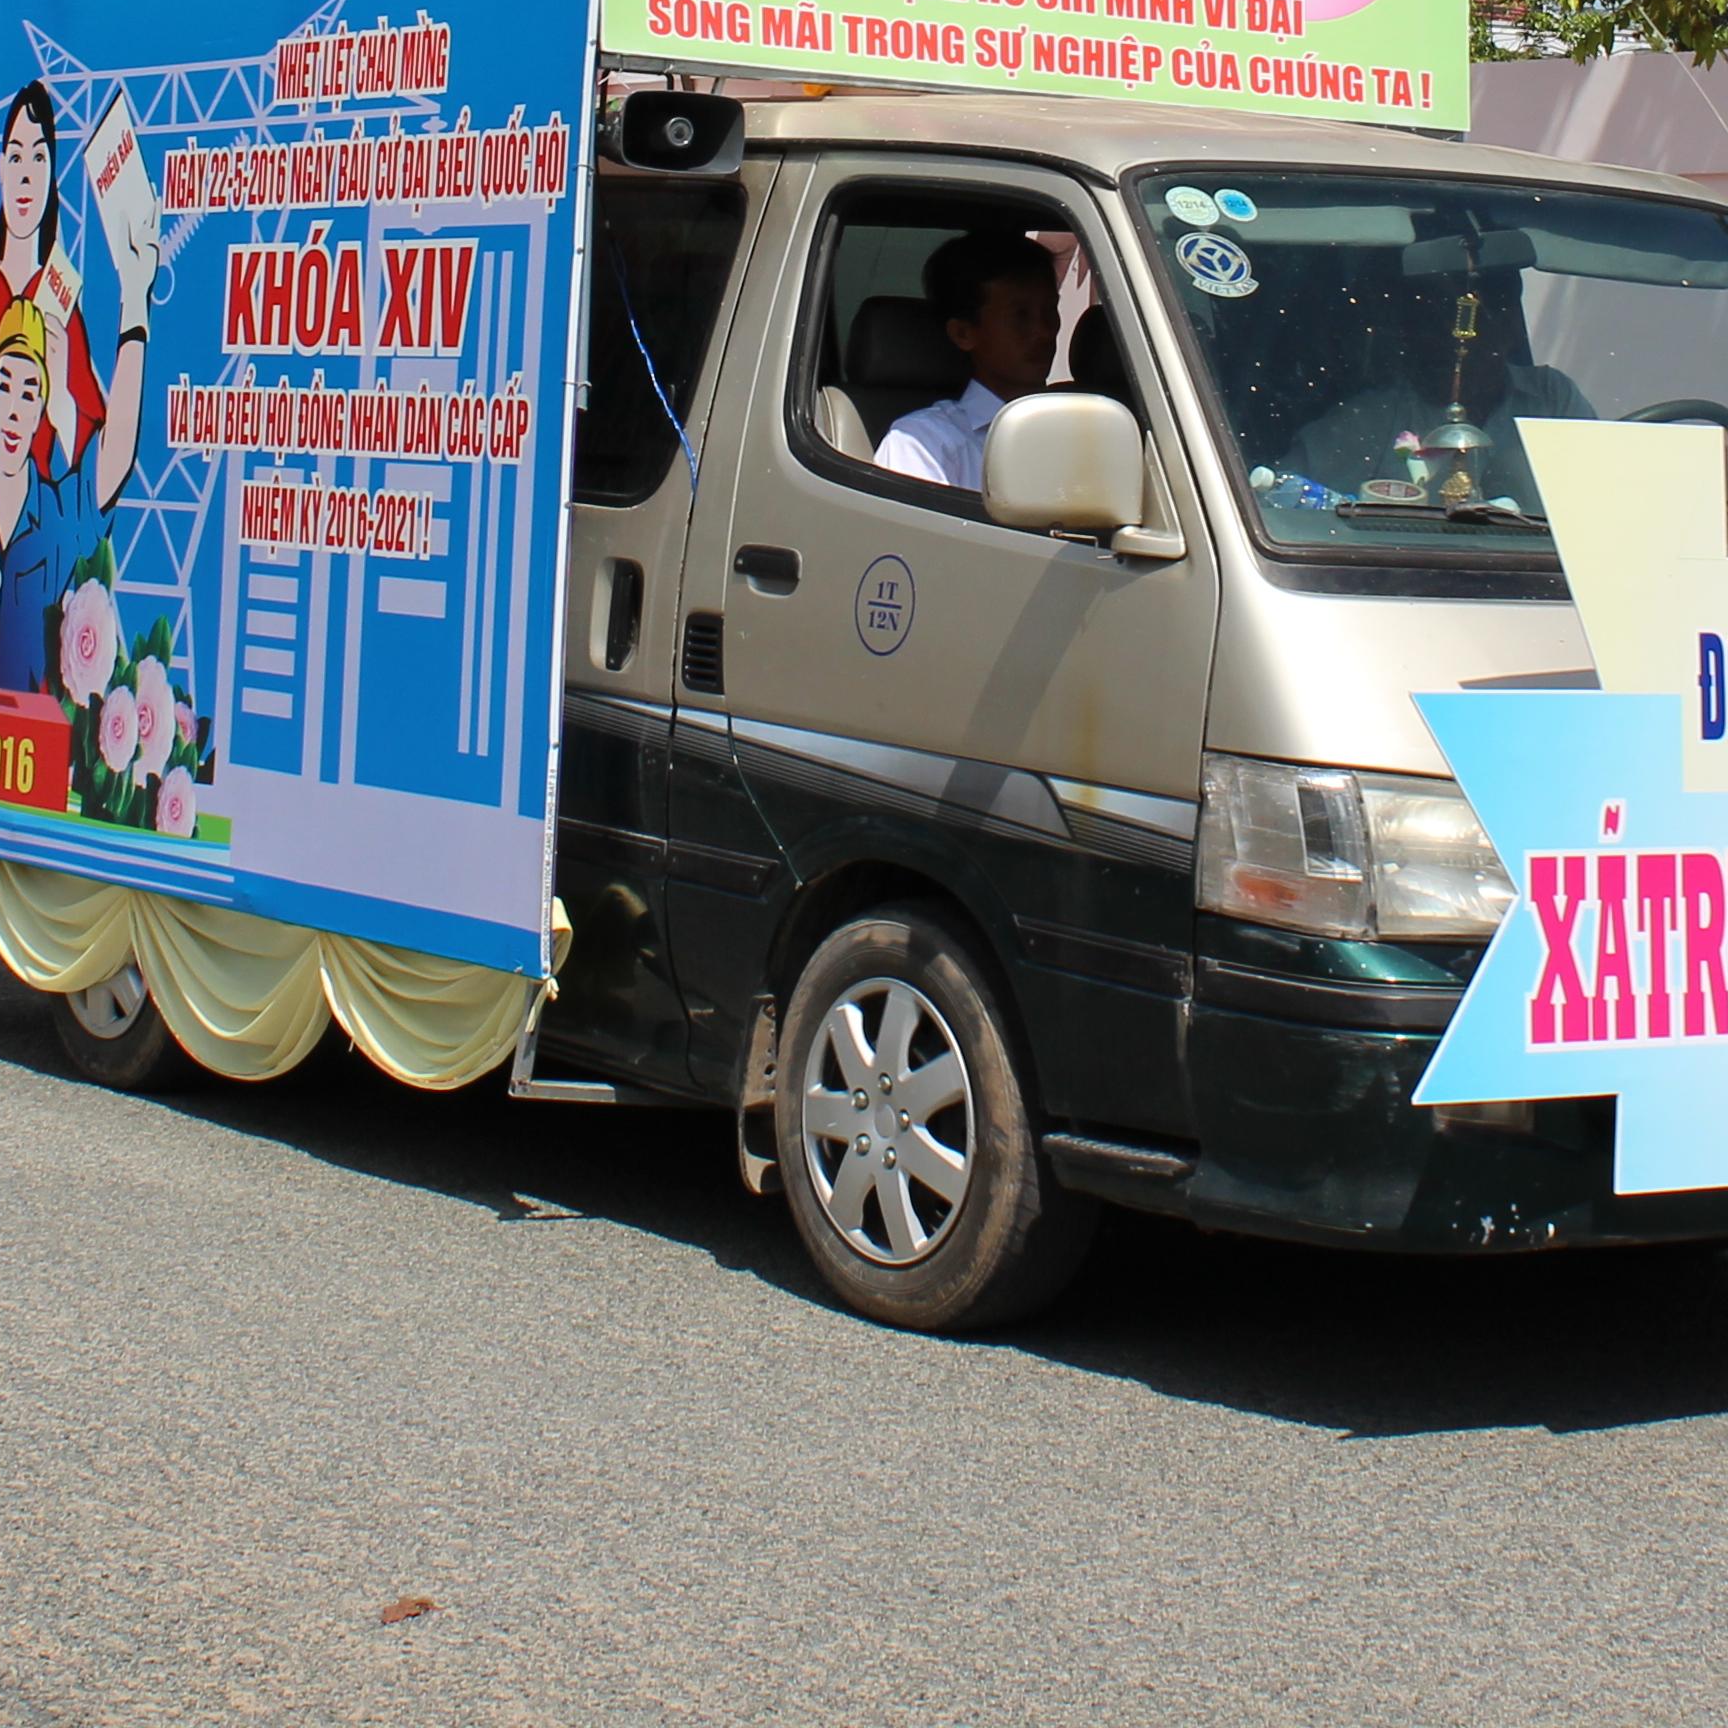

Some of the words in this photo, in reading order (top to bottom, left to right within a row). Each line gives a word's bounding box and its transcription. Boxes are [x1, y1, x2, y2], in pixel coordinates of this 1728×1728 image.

[276, 28, 320, 112] NHIỆT
[322, 24, 354, 110] LIỆT
[356, 20, 398, 94] CHÀO
[400, 14, 448, 90] MỪNG
[761, 2, 834, 50] MÃI
[841, 19, 966, 66] TRONG
[975, 27, 1026, 76] SỰ
[1031, 36, 1162, 88] NGHIỆP
[1171, 43, 1242, 92] CỦA
[1249, 50, 1366, 102] CHÚNG
[1373, 66, 1410, 106] TA
[165, 142, 208, 210] NGÀY
[208, 148, 288, 208] 22-5-2016
[290, 132, 336, 204] NGÀY
[337, 121, 372, 202] BẦU
[374, 114, 402, 200] CỬ
[401, 135, 434, 214] ĐẠI
[434, 110, 478, 198] BIỂU
[480, 111, 530, 204] QUỐC
[533, 117, 568, 208] HỘI
[226, 228, 362, 348] KHÓA
[378, 247, 474, 348] XIV
[170, 378, 190, 444] VÀ
[193, 390, 220, 456] ĐẠI
[224, 368, 262, 446] BIỂU
[265, 380, 294, 460] HỘI
[297, 373, 346, 450] ĐỒNG
[348, 382, 400, 452] NHÂN
[403, 383, 442, 456] DÂN
[446, 384, 486, 458] CÁC
[489, 376, 530, 458] CẤP
[241, 474, 296, 554] NHIỆM
[299, 477, 322, 546] KỲ
[325, 490, 416, 554] 2016-2021
[869, 610, 900, 632] 12N
[878, 581, 900, 600] 1T
